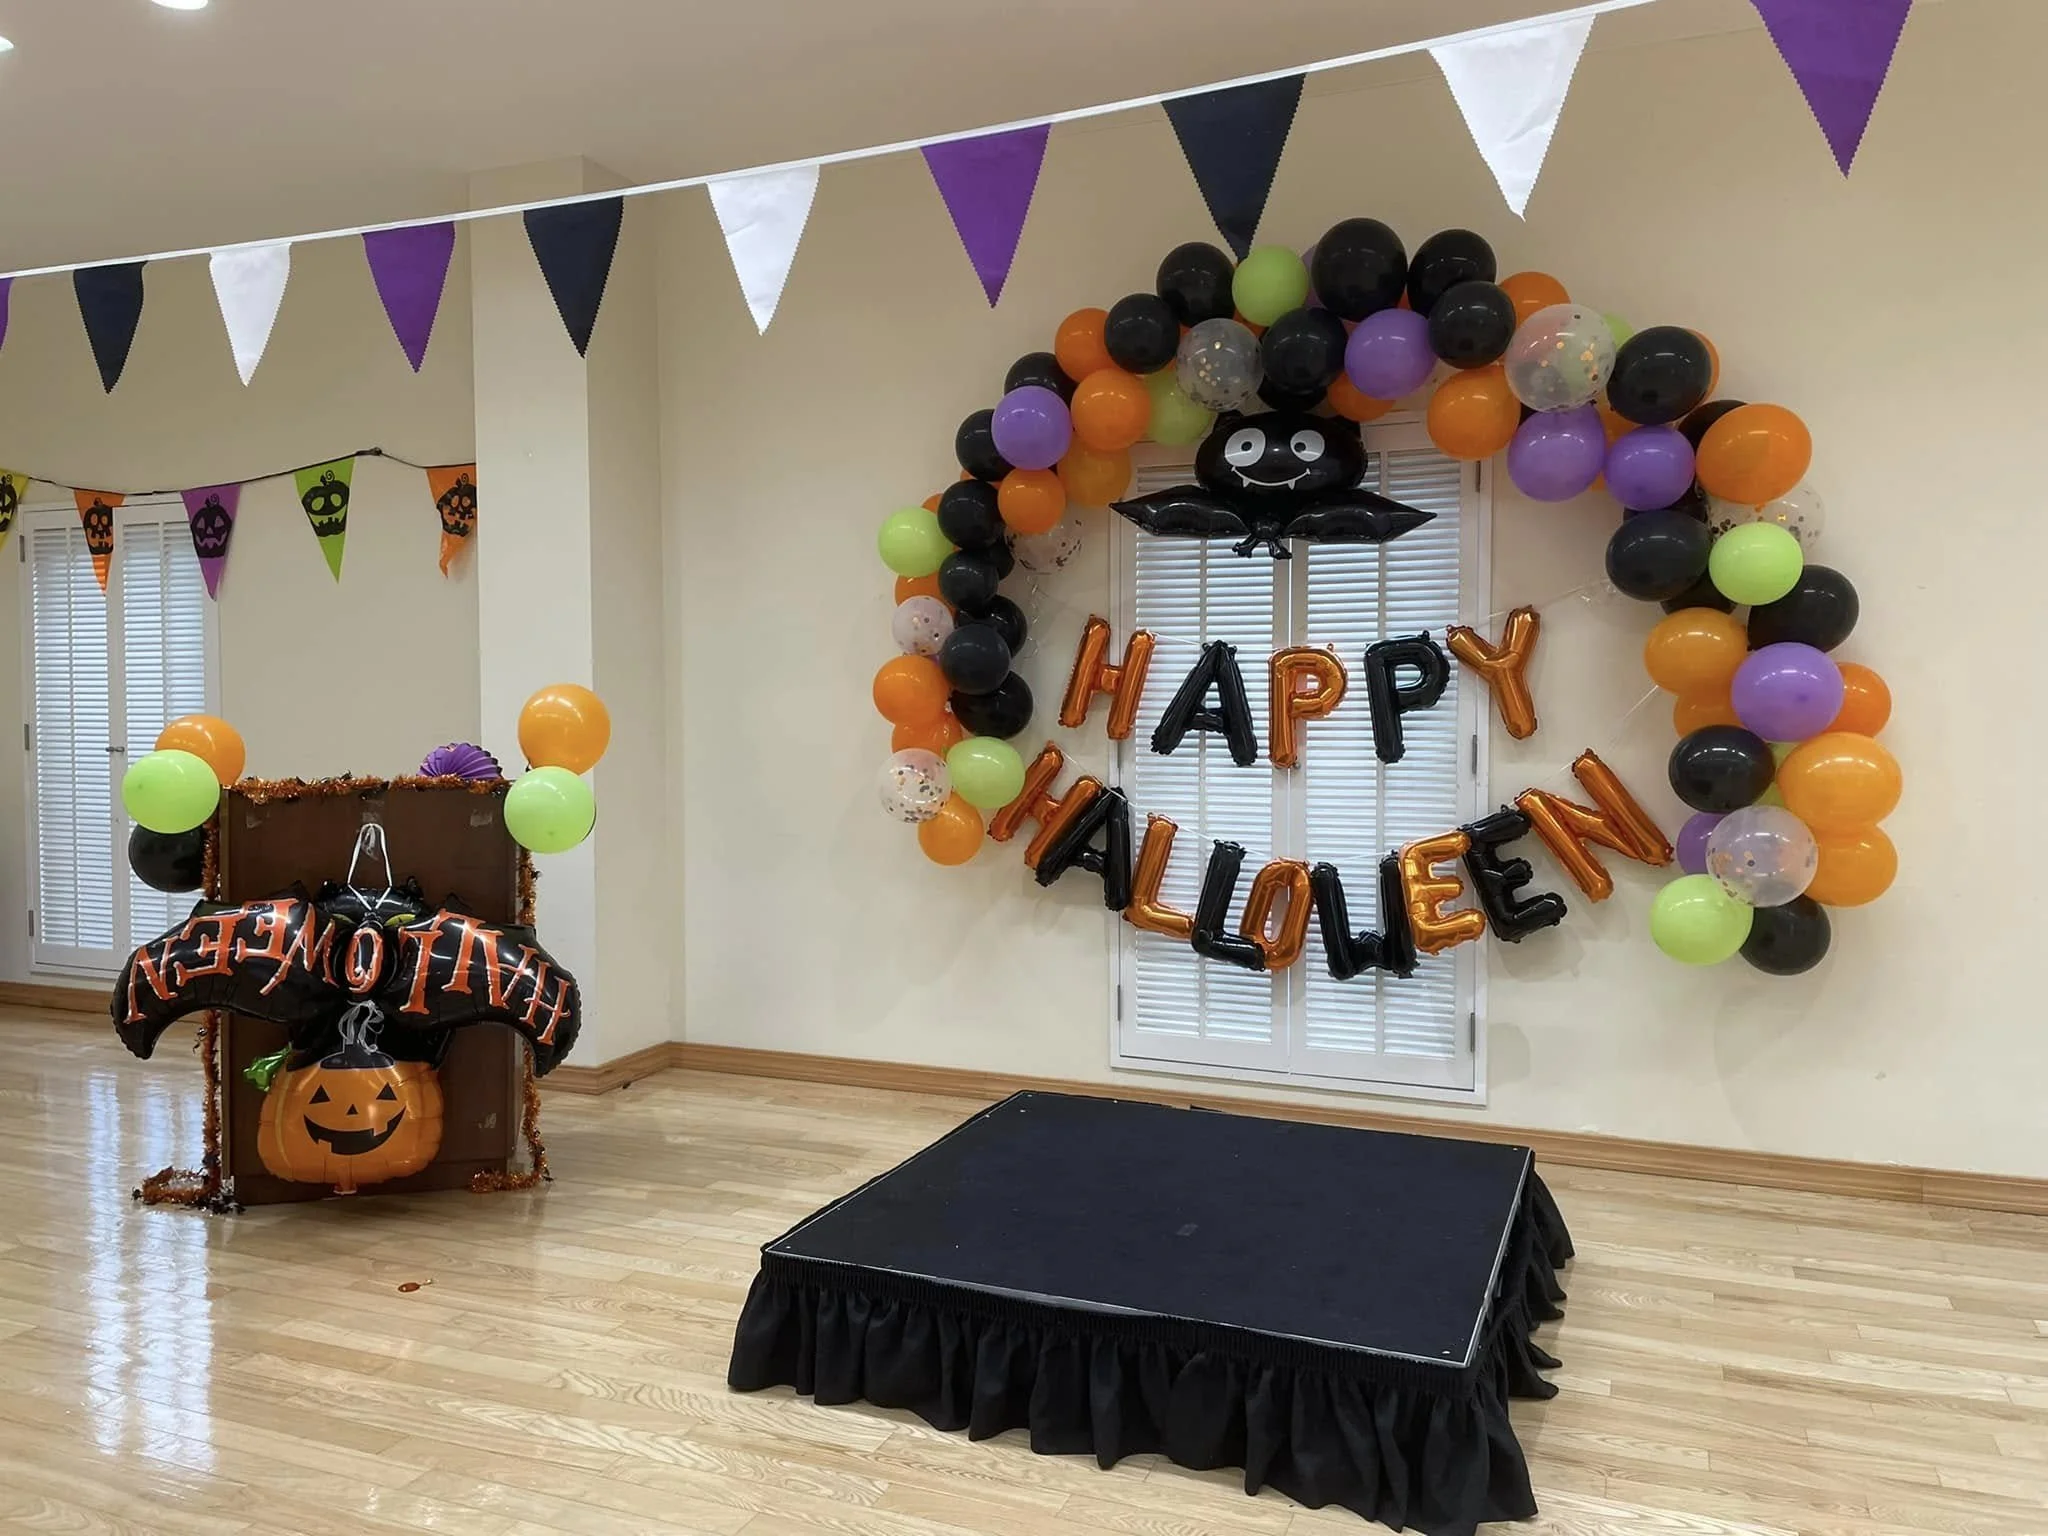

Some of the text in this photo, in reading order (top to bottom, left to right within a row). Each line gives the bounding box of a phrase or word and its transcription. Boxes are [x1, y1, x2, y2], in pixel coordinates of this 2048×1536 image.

[1058, 605, 1541, 768] HAPPY
[987, 740, 1674, 980] HALLOWEEN
[125, 898, 571, 1045] HALLOWEEN
